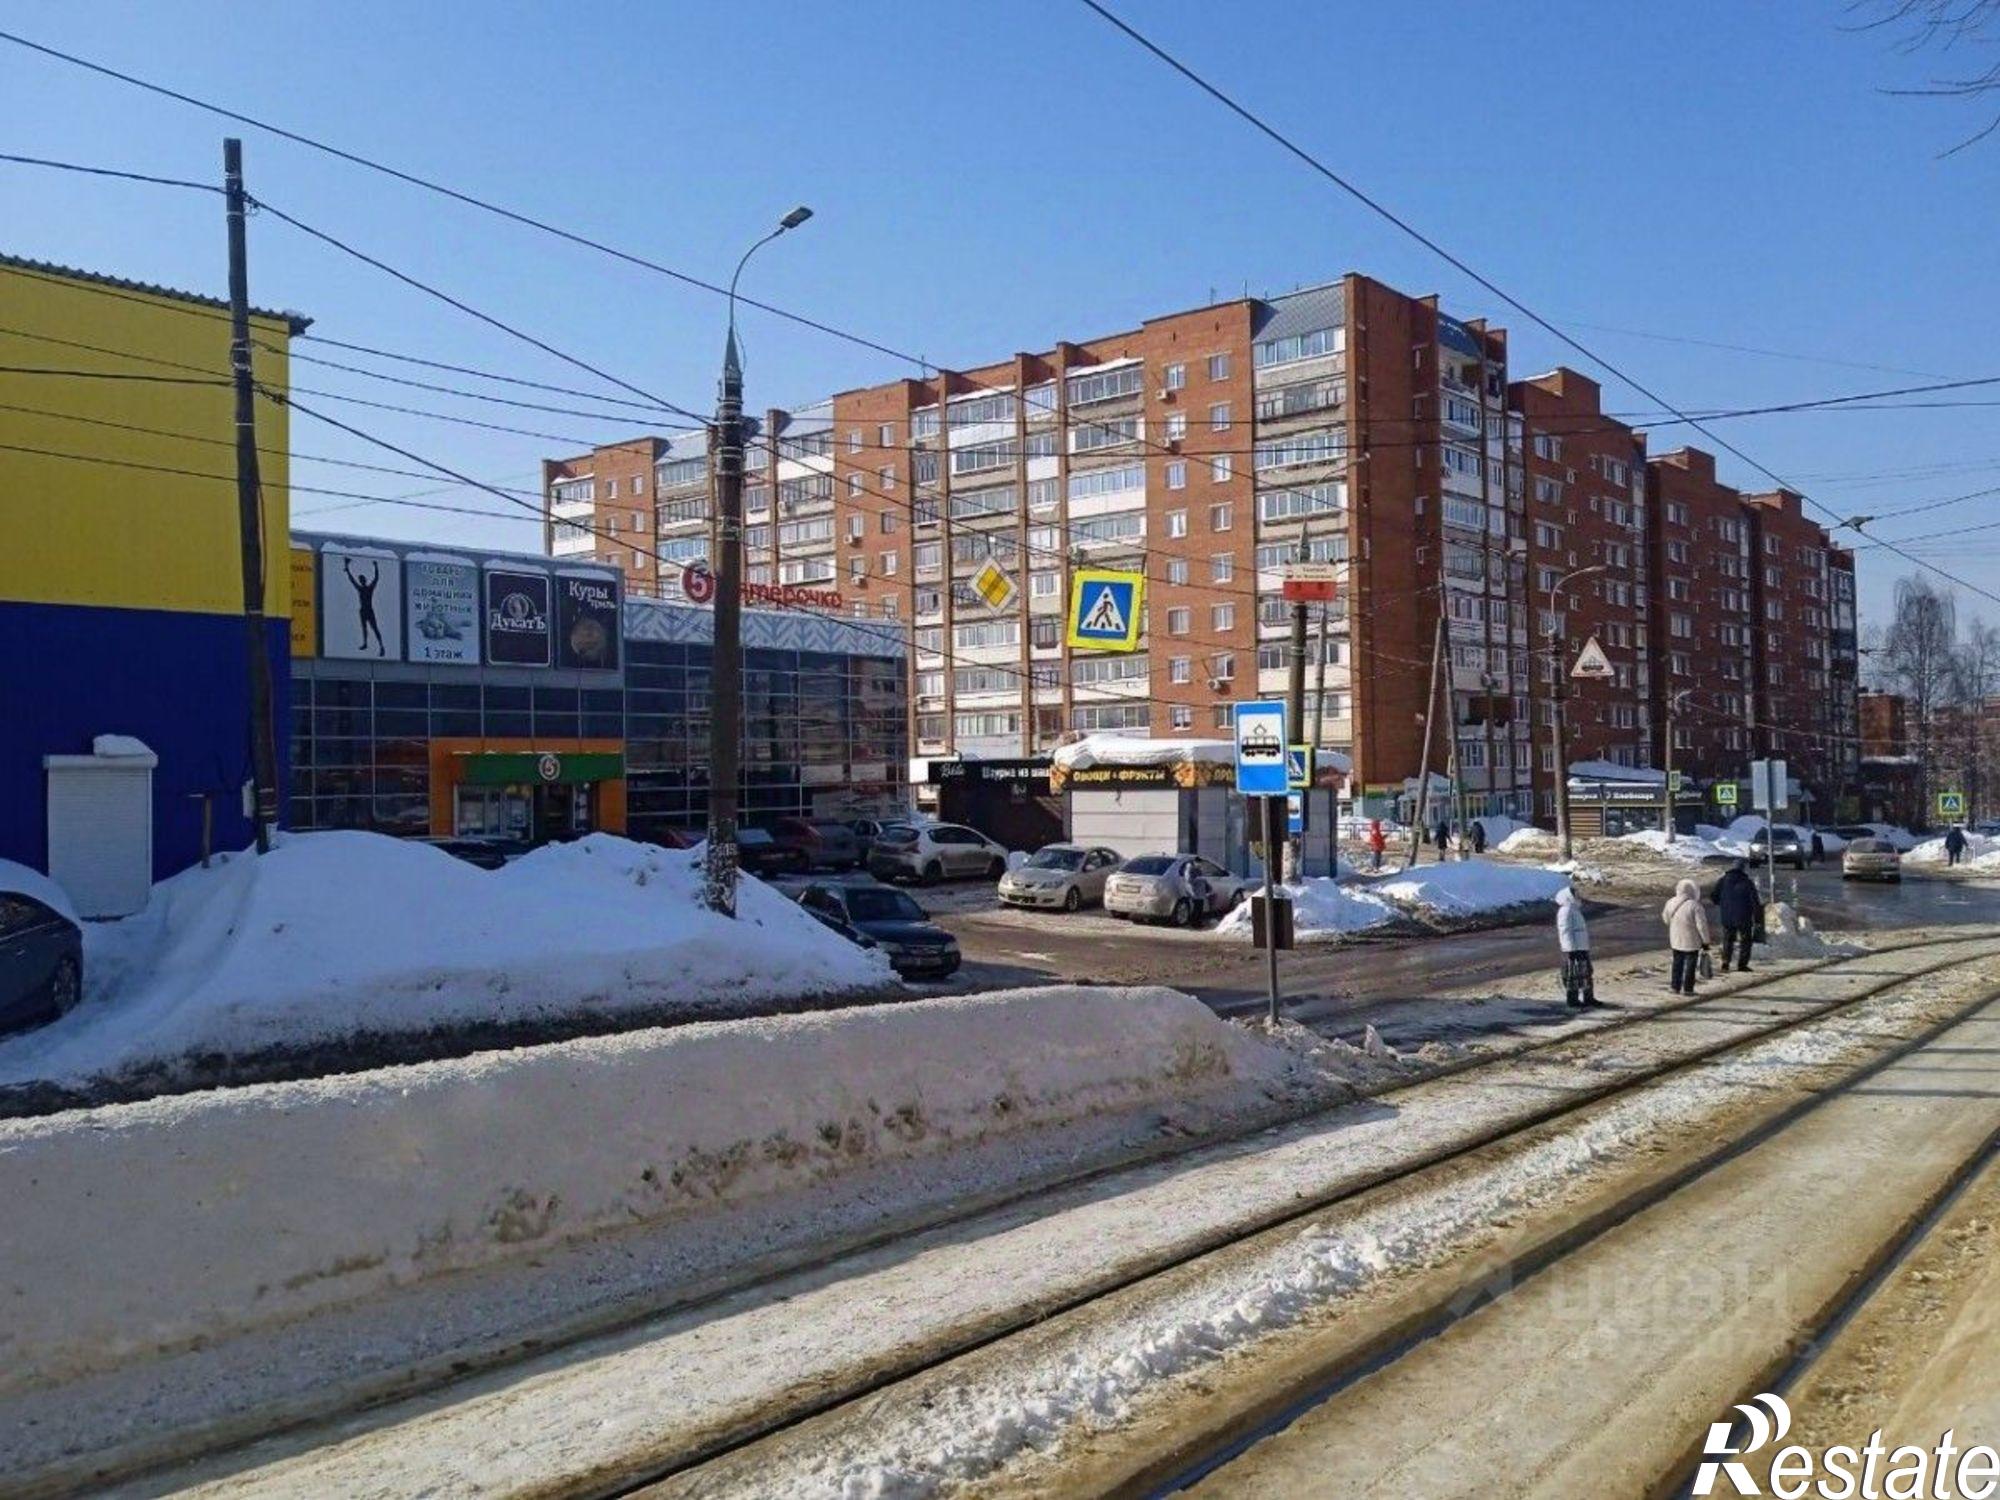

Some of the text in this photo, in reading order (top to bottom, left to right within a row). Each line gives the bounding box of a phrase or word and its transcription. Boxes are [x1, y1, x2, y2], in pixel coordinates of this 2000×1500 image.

[569, 580, 608, 602] Куры
[737, 581, 842, 608] ятёрочка
[424, 646, 431, 658] 1
